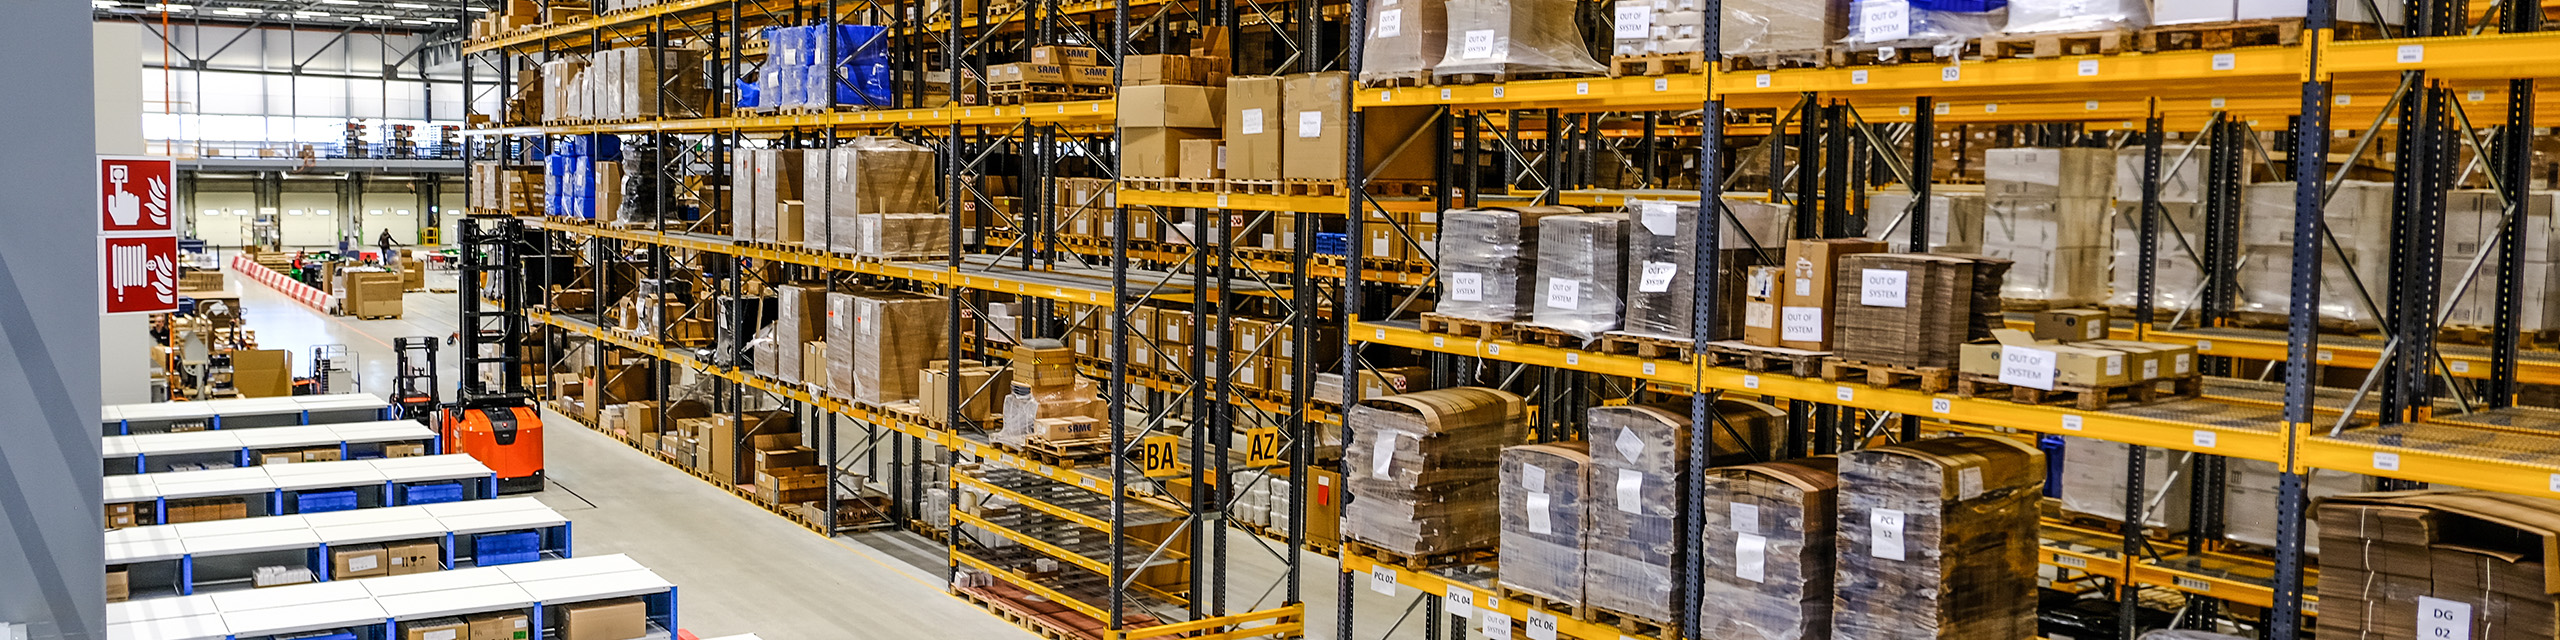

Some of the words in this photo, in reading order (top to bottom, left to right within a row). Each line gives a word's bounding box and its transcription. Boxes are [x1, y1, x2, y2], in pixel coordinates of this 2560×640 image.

[1620, 12, 1633, 20] OUT
[1634, 12, 1642, 20] OF
[1871, 12, 1886, 21] OUT
[1888, 10, 1898, 19] OF
[1619, 24, 1642, 32] SYSTEM
[1870, 24, 1899, 34] SYSTEM
[1066, 49, 1089, 58] SAME
[1038, 66, 1060, 74] SAME
[1085, 68, 1107, 76] SAME
[1944, 69, 1958, 78] 30
[1494, 87, 1502, 96] 30
[1869, 276, 1885, 286] OUT
[1886, 276, 1897, 286] OF
[1552, 295, 1572, 303] SYSTEM
[1869, 290, 1898, 298] SYSTEM
[1787, 314, 1802, 322] OUT
[1803, 314, 1812, 322] OF
[1787, 326, 1813, 334] SYSTEM
[1490, 345, 1498, 353] 20
[2008, 353, 2028, 364] OUT
[2029, 355, 2042, 366] OF
[2007, 367, 2042, 380] SYSTEM
[1934, 400, 1948, 410] 20
[1067, 423, 1092, 433] SAME
[1250, 433, 1275, 461] AZ
[1147, 442, 1175, 470] BA
[1880, 516, 1895, 526] PCL
[1883, 530, 1893, 539] 12
[1374, 571, 1384, 582] PCL
[1385, 574, 1394, 584] 02
[1449, 592, 1460, 604] PCL
[1461, 596, 1470, 605] 04
[1489, 598, 1497, 606] 10
[2433, 608, 2454, 621] DG
[1487, 615, 1499, 625] OUT
[1500, 617, 1506, 626] OF
[1529, 616, 1543, 628] PCL
[1543, 620, 1554, 631] 06
[1486, 626, 1507, 636] SYSTEM
[2434, 627, 2451, 639] 02
